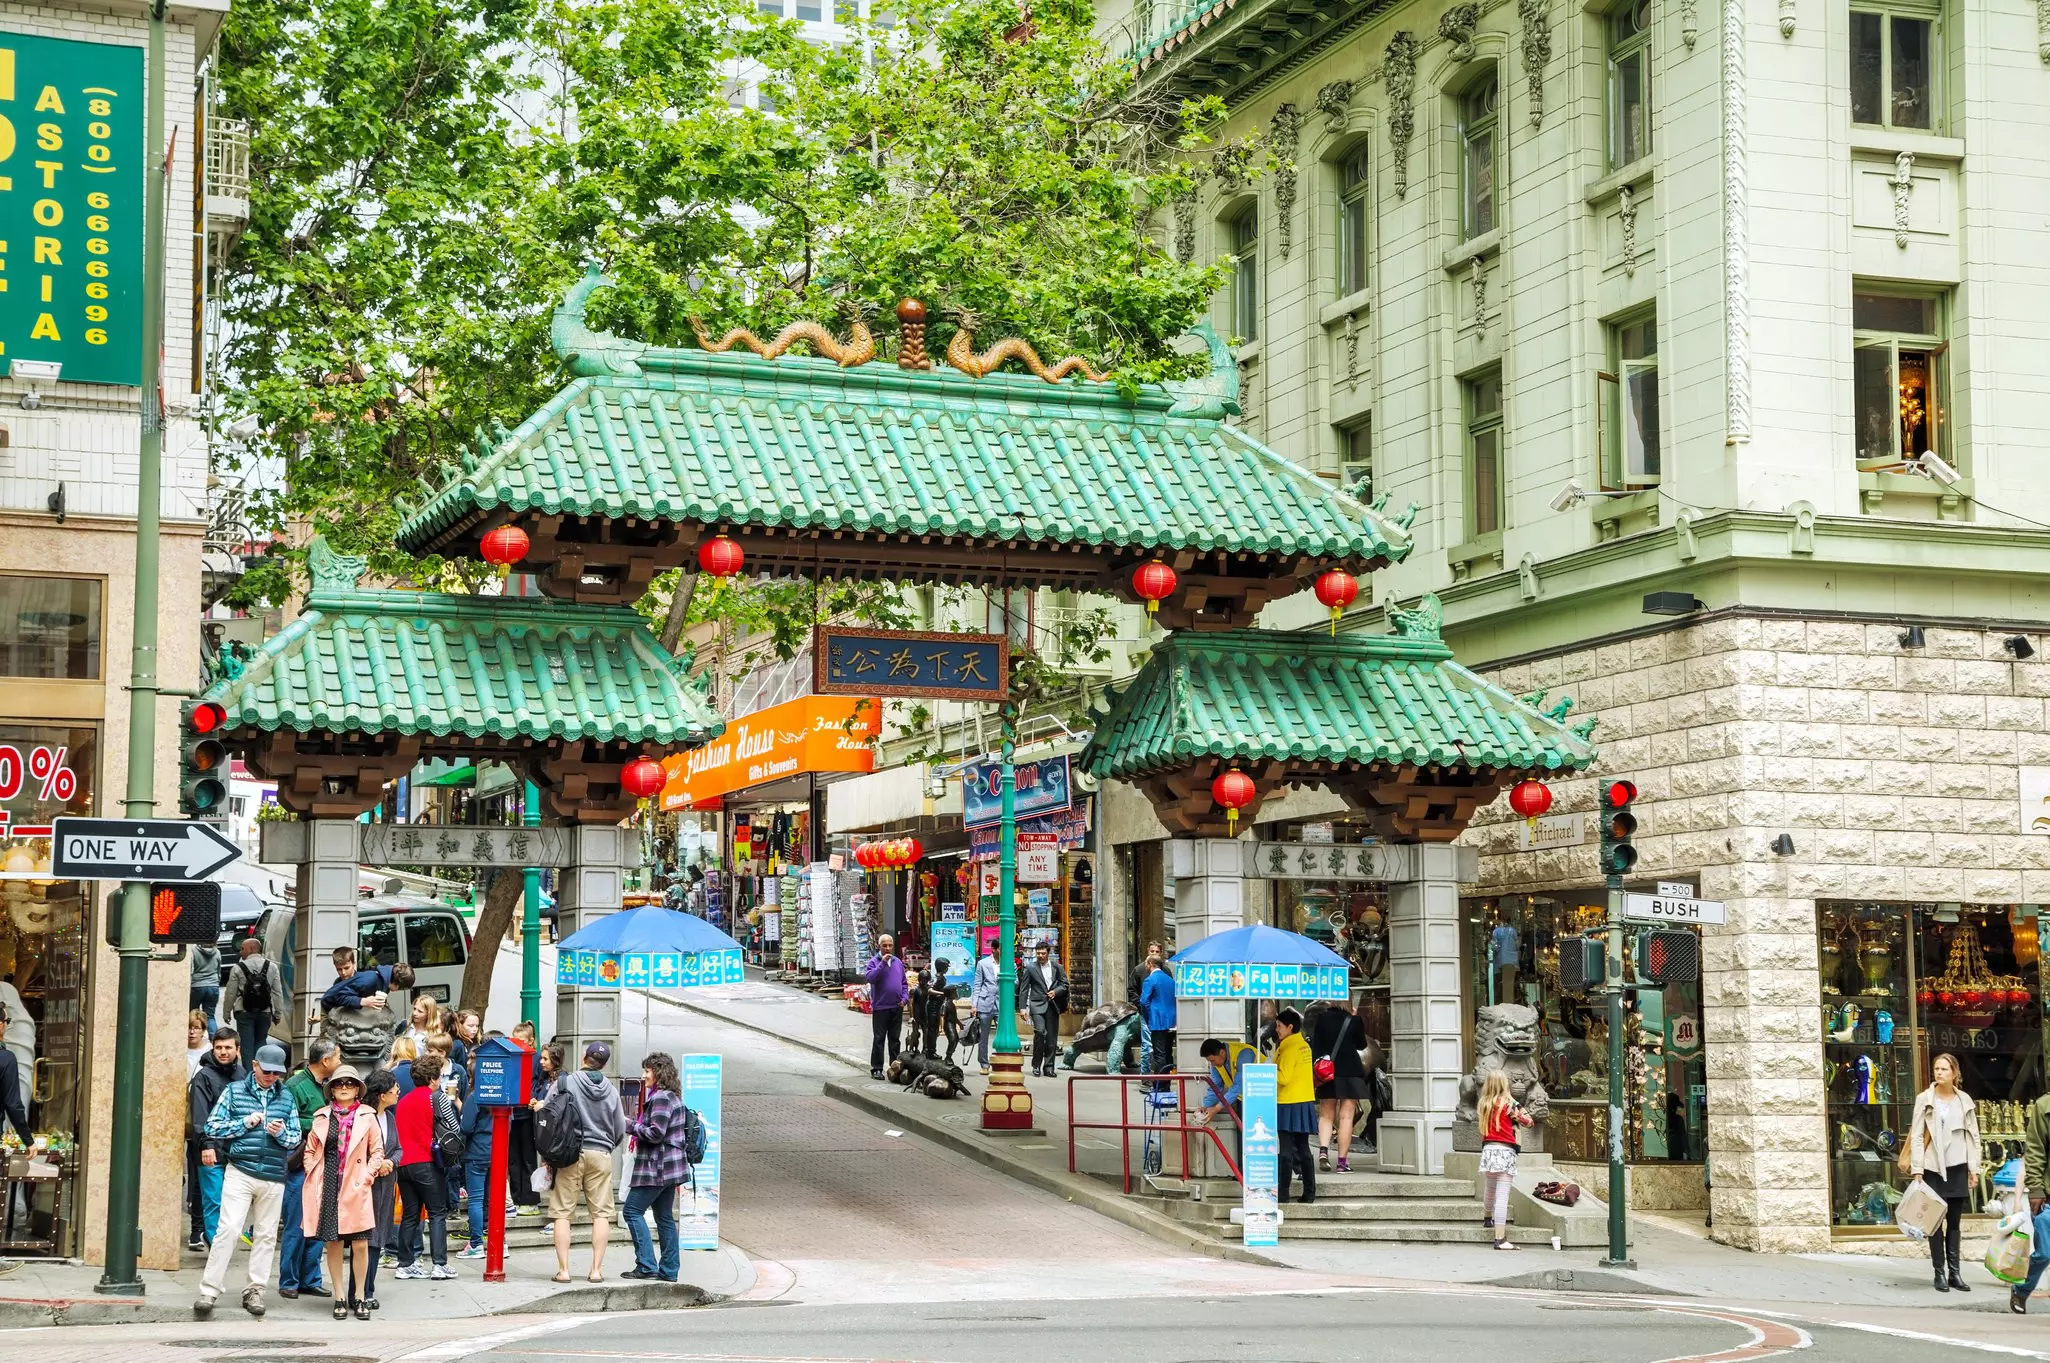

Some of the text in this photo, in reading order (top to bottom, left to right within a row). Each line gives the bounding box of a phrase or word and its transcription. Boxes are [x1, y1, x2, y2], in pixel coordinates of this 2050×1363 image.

[30, 85, 66, 342] ASTORIA
[84, 192, 111, 346] 6666696
[812, 716, 868, 732] Fason
[735, 723, 775, 761] House
[769, 756, 798, 776] Souvenirs
[69, 838, 178, 861] ONE WAY
[1018, 841, 1057, 851] NO STOPPING
[1028, 855, 1047, 863] ANY
[1028, 864, 1048, 872] TIME
[1672, 885, 1690, 896] 500
[944, 912, 964, 920] ATM
[1652, 900, 1700, 918] BUSH
[726, 955, 740, 969] Fa
[1251, 971, 1269, 984] Fa
[1275, 972, 1297, 985] Lun
[1301, 974, 1317, 985] Da
[1334, 974, 1344, 986] is
